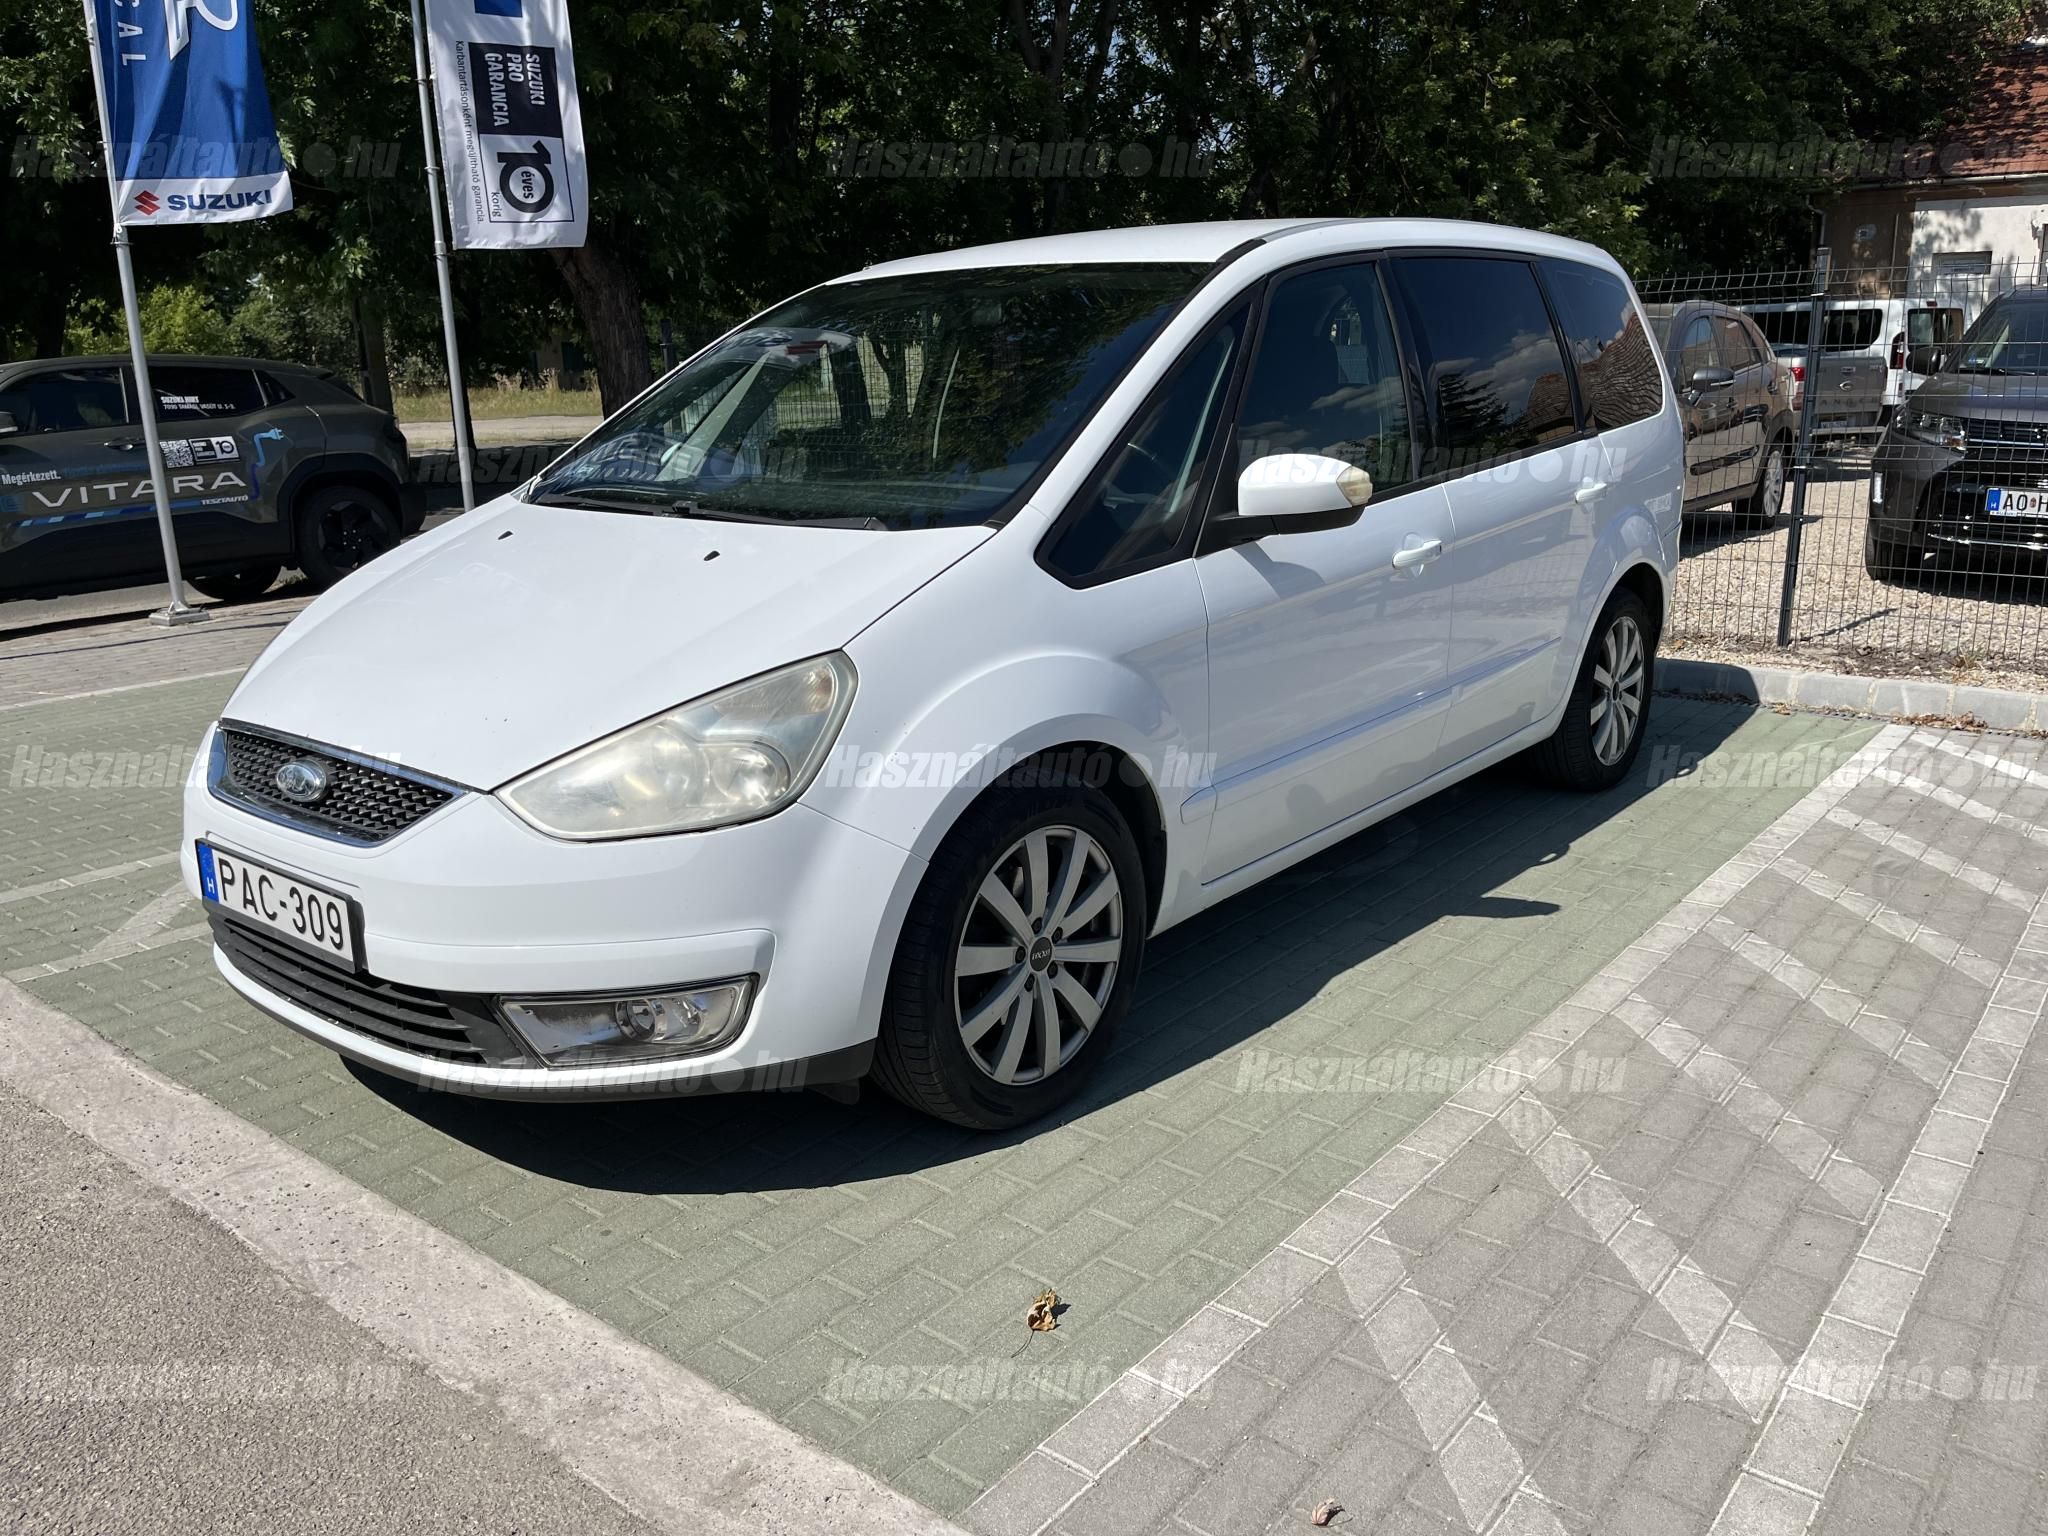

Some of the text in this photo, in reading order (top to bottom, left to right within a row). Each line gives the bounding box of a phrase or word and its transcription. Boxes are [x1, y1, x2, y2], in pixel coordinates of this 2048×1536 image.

[455, 40, 472, 128] Karbantartásonként
[506, 52, 525, 83] PRO
[526, 53, 546, 106] SUZUKI
[484, 52, 510, 127] GARANCIA
[167, 190, 273, 211] SUZUKI
[520, 170, 534, 200] éves
[1, 470, 61, 486] Megérkezett.
[32, 472, 246, 508] VITARA
[206, 857, 343, 950] H PAC-309
